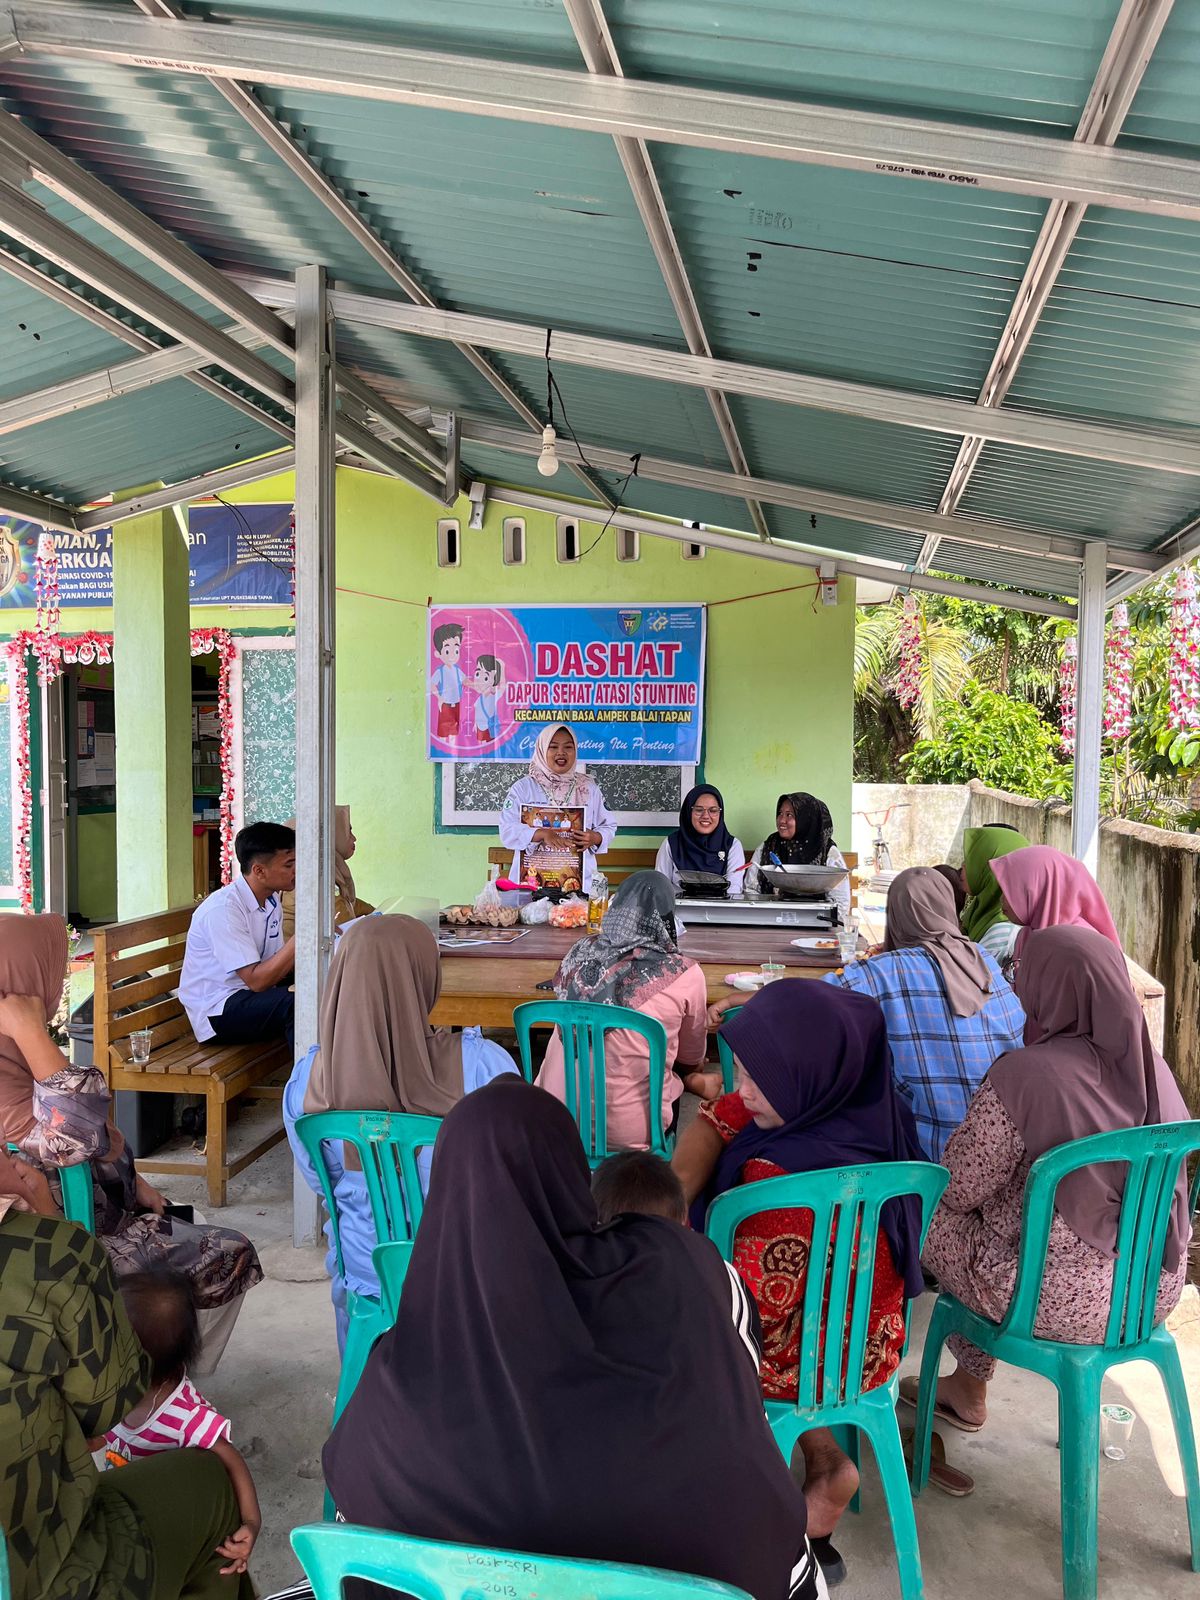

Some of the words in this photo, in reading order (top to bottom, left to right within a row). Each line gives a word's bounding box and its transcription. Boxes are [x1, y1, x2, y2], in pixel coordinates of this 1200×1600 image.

[79, 581, 97, 590] BAGI
[536, 642, 682, 677] DASHAT
[507, 682, 549, 705] DAPUR
[552, 683, 592, 705] SEHAT
[594, 683, 631, 705] ATASI
[634, 683, 697, 705] STUNTING
[514, 710, 570, 721] KECAMATAN
[572, 711, 594, 722] BASA
[596, 711, 629, 722] AMPEK
[630, 711, 658, 722] BALAI
[660, 711, 691, 722] TAPAN
[610, 737, 628, 750] Itu
[632, 737, 675, 752] Penting
[481, 1581, 518, 1597] 2013
